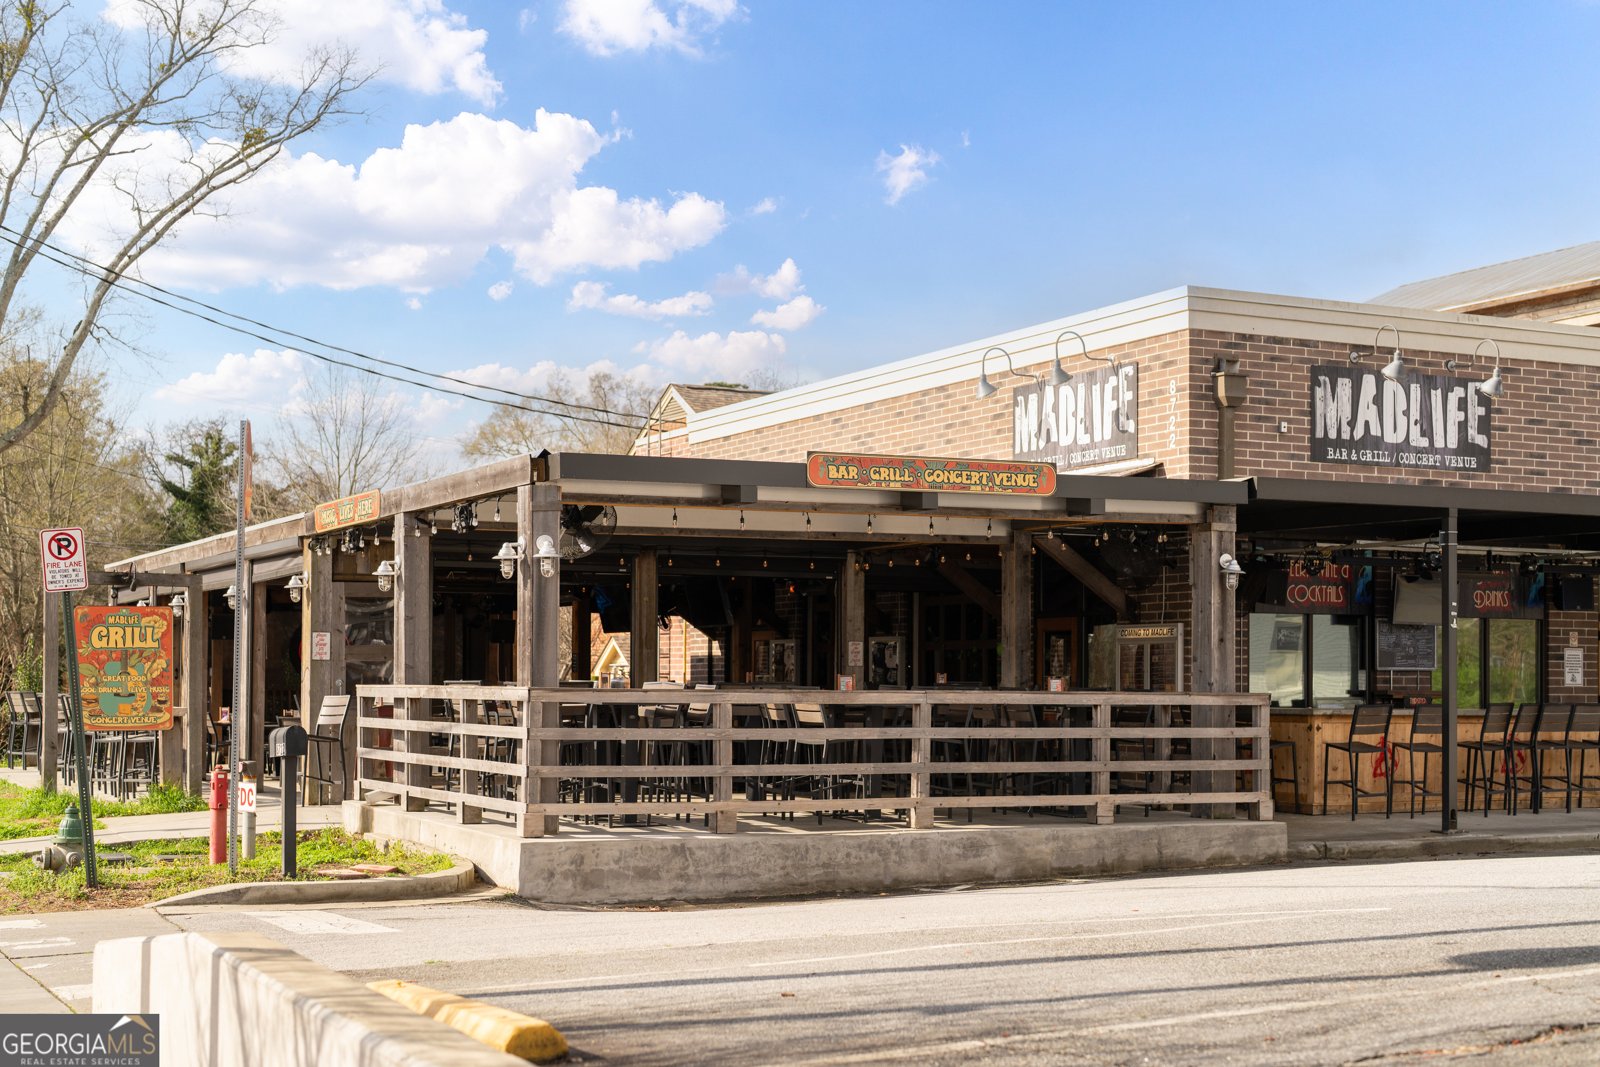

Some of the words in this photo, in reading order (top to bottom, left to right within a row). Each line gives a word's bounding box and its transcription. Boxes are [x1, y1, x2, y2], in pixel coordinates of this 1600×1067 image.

[1014, 365, 1136, 455] MADLIFE
[1169, 379, 1177, 448] 8722
[1315, 374, 1488, 449] MADLIFE
[1069, 448, 1099, 463] CONCERT
[1101, 445, 1127, 459] VENUE
[1327, 447, 1348, 460] BAR
[1351, 450, 1357, 460] &
[1360, 450, 1391, 463] GRILL
[1398, 453, 1441, 466] CONCERT
[1444, 455, 1477, 468] VENUE
[827, 464, 859, 480] BAR
[869, 467, 914, 483] GRILL
[924, 469, 990, 486] CONCERT
[993, 472, 1038, 487] VENUE
[357, 499, 373, 516] HERE
[64, 560, 83, 568] LANE
[1289, 559, 1310, 578] EER,
[1286, 584, 1344, 604] COCKTAILS
[1473, 590, 1509, 609] DRINKS
[108, 615, 139, 625] MADLIFE
[91, 625, 159, 649] GRILL
[1120, 629, 1141, 637] COMING
[1142, 628, 1149, 636] TO
[1150, 627, 1175, 636] MADLIFE
[90, 715, 128, 724] CONCERT
[129, 715, 158, 724] VENUE
[238, 787, 254, 807] DC
